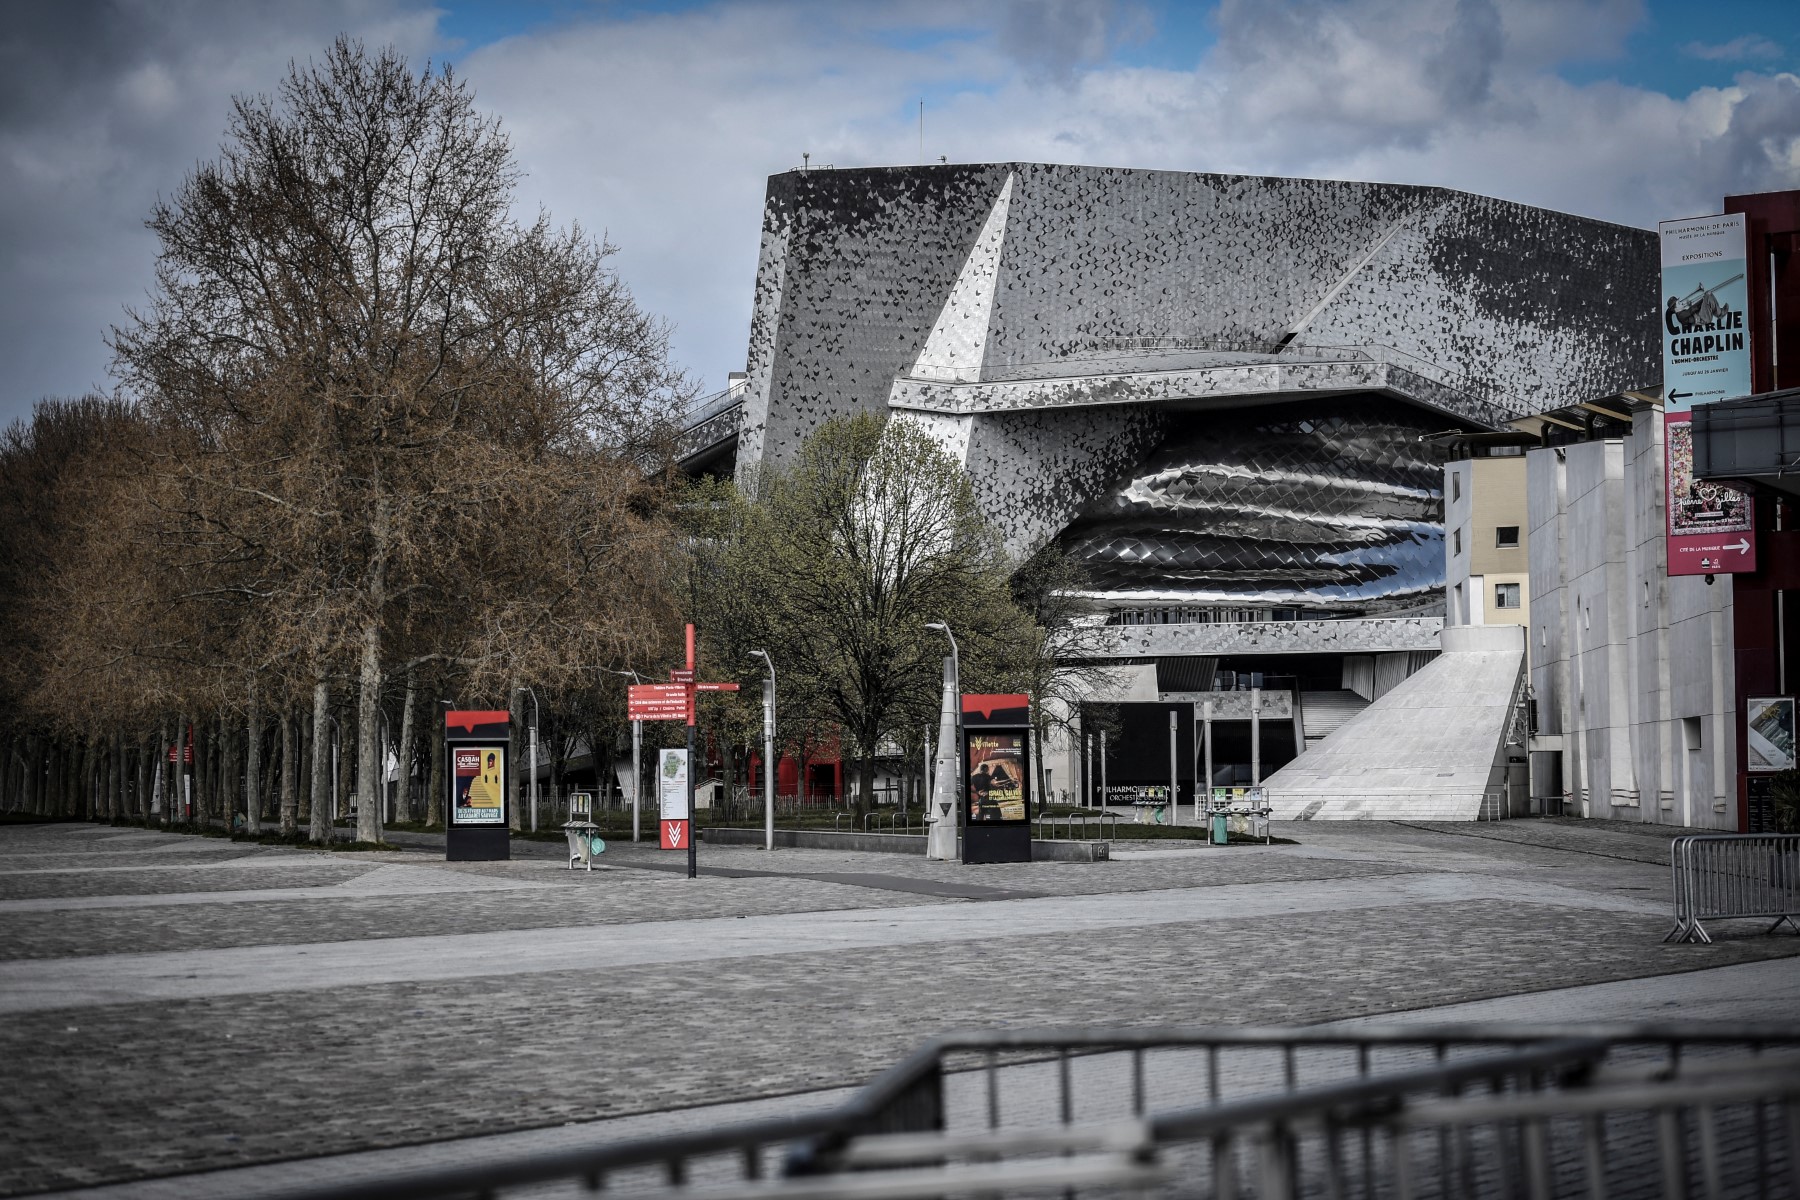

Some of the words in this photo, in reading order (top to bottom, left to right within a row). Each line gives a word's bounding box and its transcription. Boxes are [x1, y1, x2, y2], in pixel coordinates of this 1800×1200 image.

[1665, 225, 1710, 235] PHILHARMONIE
[1682, 250, 1722, 260] EXPOSITIONS
[1671, 332, 1744, 356] CHAPLIN
[1671, 354, 1718, 364] L'HOMME-ORCHESTRE
